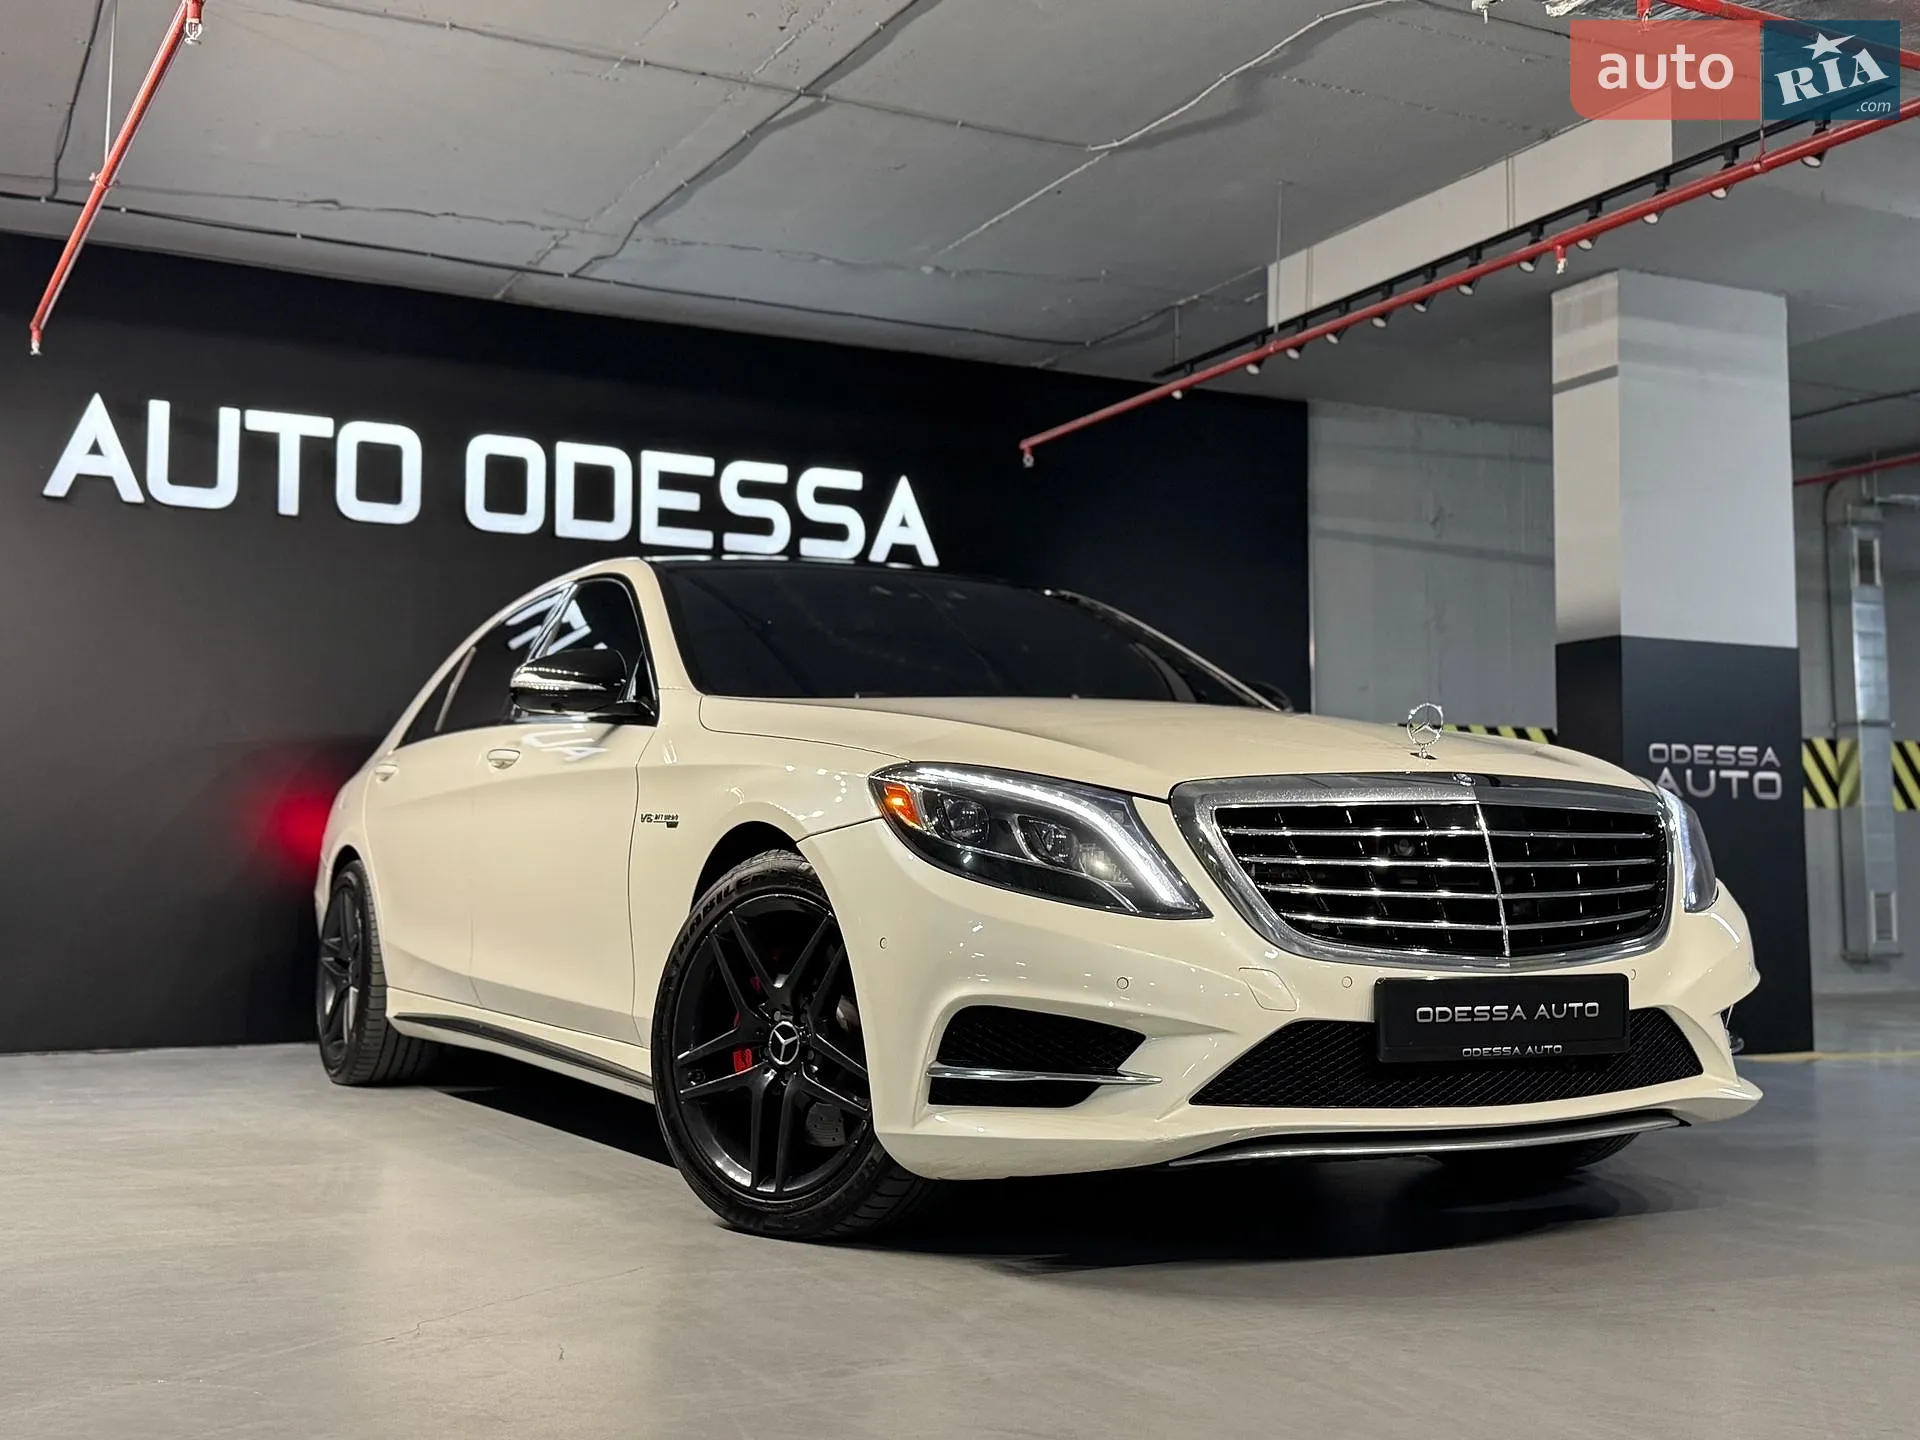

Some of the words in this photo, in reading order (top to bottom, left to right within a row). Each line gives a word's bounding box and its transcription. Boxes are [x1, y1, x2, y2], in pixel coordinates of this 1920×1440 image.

[43, 392, 422, 525] AUTO
[465, 433, 939, 567] ODESSA
[1648, 743, 1781, 768] ODESSA
[1656, 767, 1782, 800] AUTO
[1416, 1004, 1526, 1023] ODESSA
[1534, 1002, 1600, 1020] AUTO
[1462, 1046, 1521, 1057] ODESSA
[1526, 1044, 1562, 1055] AUTO
